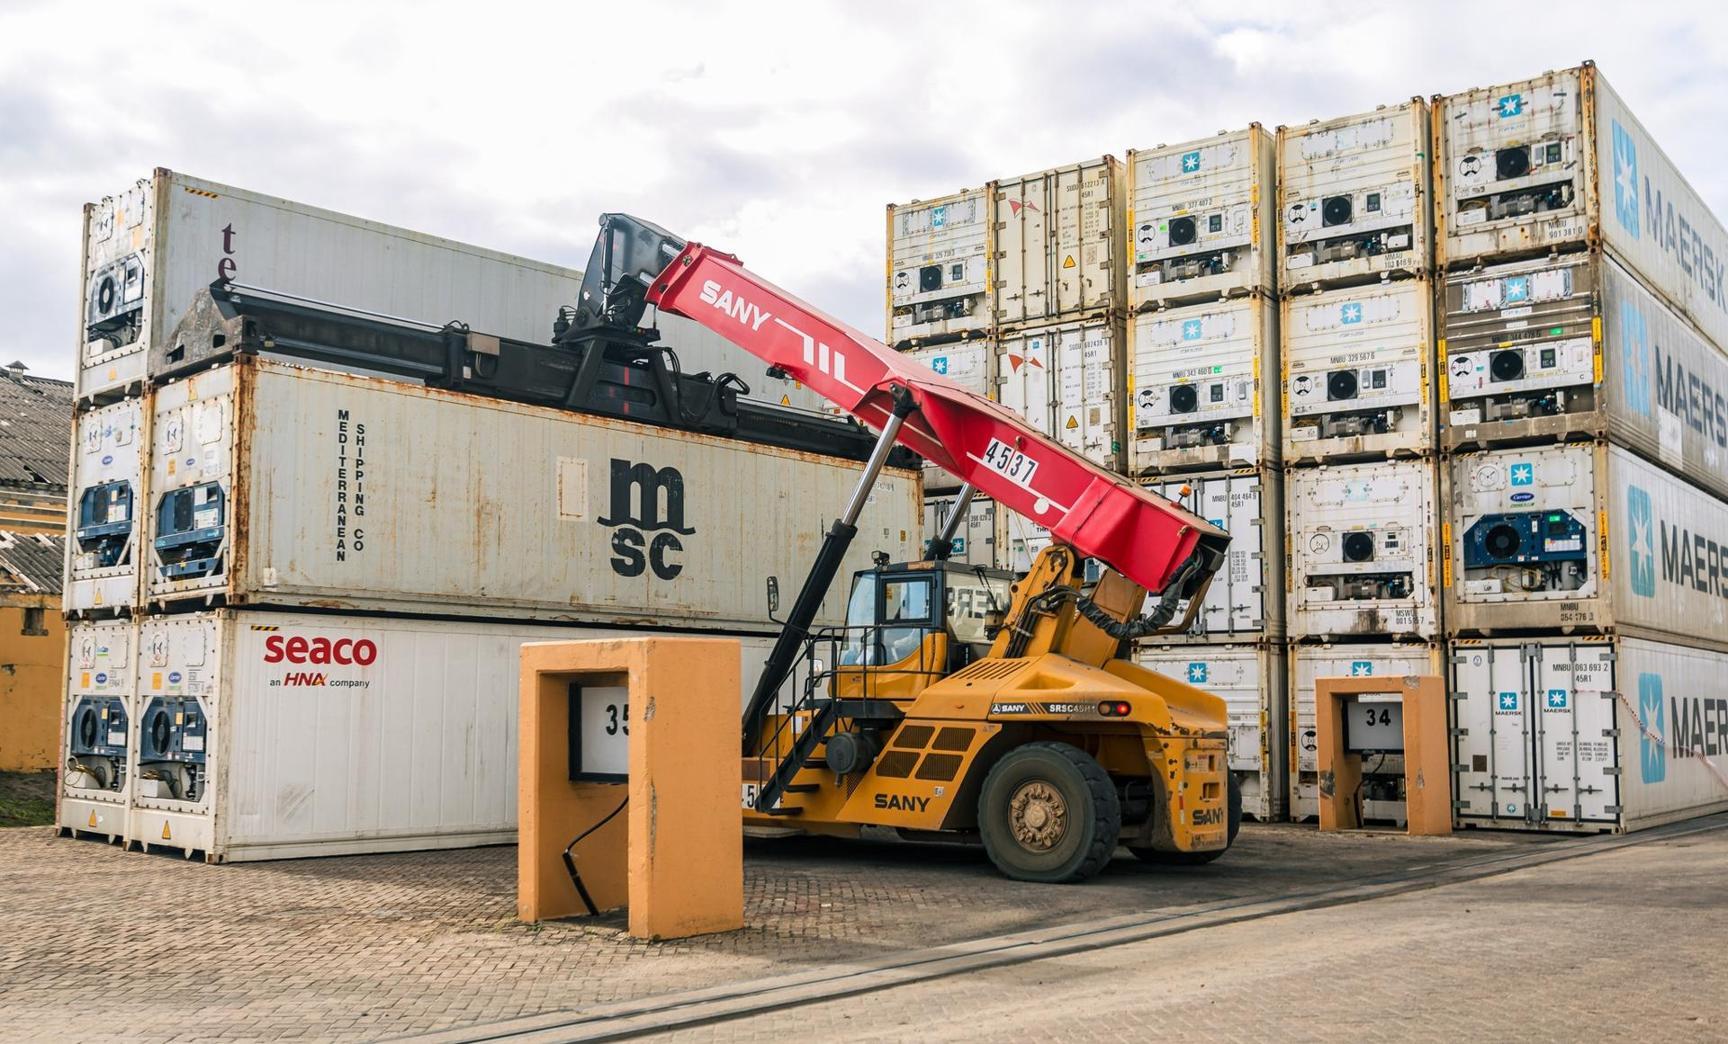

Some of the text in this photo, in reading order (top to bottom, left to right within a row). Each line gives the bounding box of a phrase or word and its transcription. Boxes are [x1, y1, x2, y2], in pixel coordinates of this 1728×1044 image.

[1549, 230, 1562, 239] 901
[1645, 175, 1727, 314] MAERSK
[699, 280, 772, 332] SANY
[1655, 345, 1728, 449] MAERS
[986, 441, 1036, 483] 4537
[337, 410, 349, 562] MEDITERRANEAN
[353, 424, 365, 551] SHIPPING CO
[264, 635, 377, 666] seaco
[1553, 663, 1572, 672] MNBU
[1589, 663, 1601, 672] 693
[1603, 663, 1609, 671] 2
[1576, 674, 1592, 683] 45R1
[284, 672, 328, 687] HNA
[330, 679, 370, 689] company
[1001, 704, 1025, 712] SANY
[1366, 708, 1392, 727] 34
[874, 793, 931, 813] SANY
